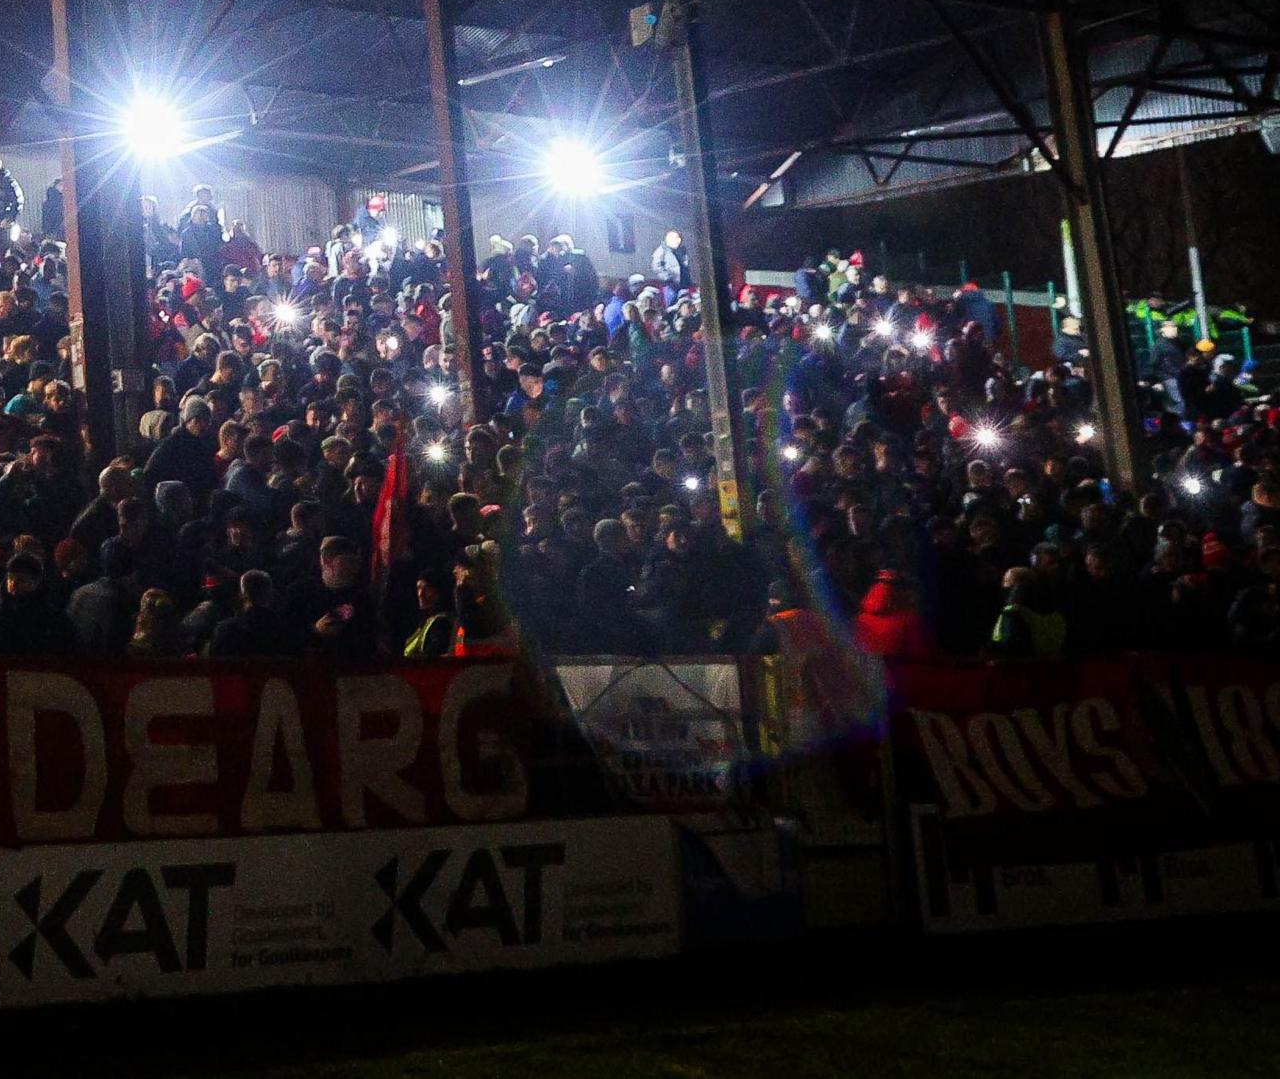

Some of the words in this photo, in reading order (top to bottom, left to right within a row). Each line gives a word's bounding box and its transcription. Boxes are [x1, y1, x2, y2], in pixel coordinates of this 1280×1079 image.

[3, 664, 534, 840] DEARG
[907, 696, 1149, 819] BOYS
[7, 862, 236, 982] KAT
[370, 843, 566, 954] KAT
